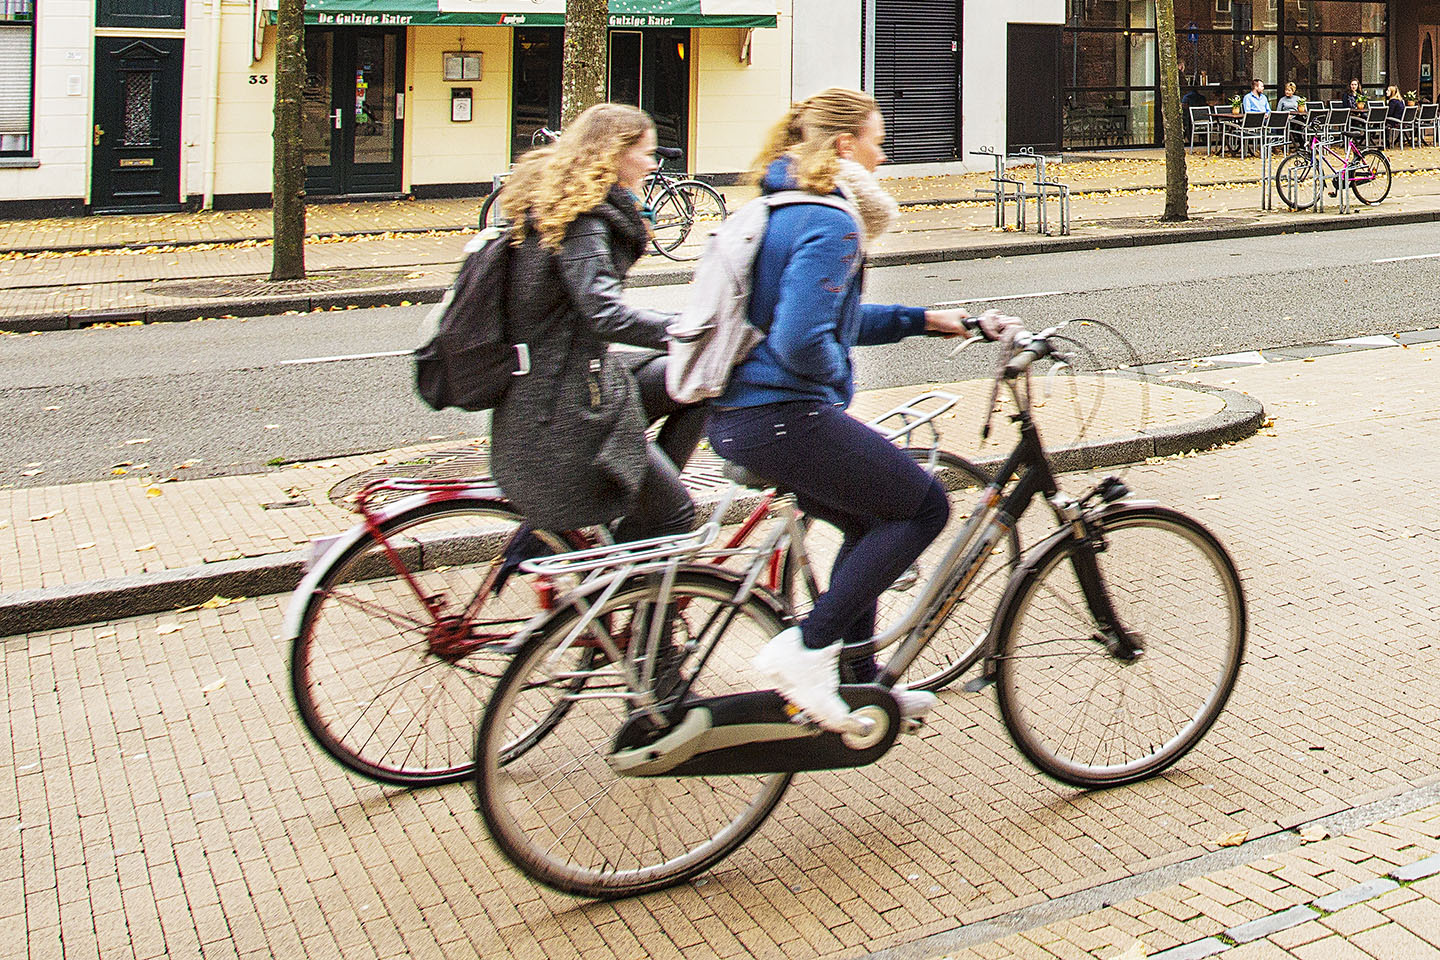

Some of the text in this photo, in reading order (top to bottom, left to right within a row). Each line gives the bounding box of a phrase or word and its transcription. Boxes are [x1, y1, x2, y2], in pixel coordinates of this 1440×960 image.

[318, 13, 413, 25] De Gulzige Kater
[608, 15, 675, 27] Gulzige Kater
[248, 74, 269, 85] 33
